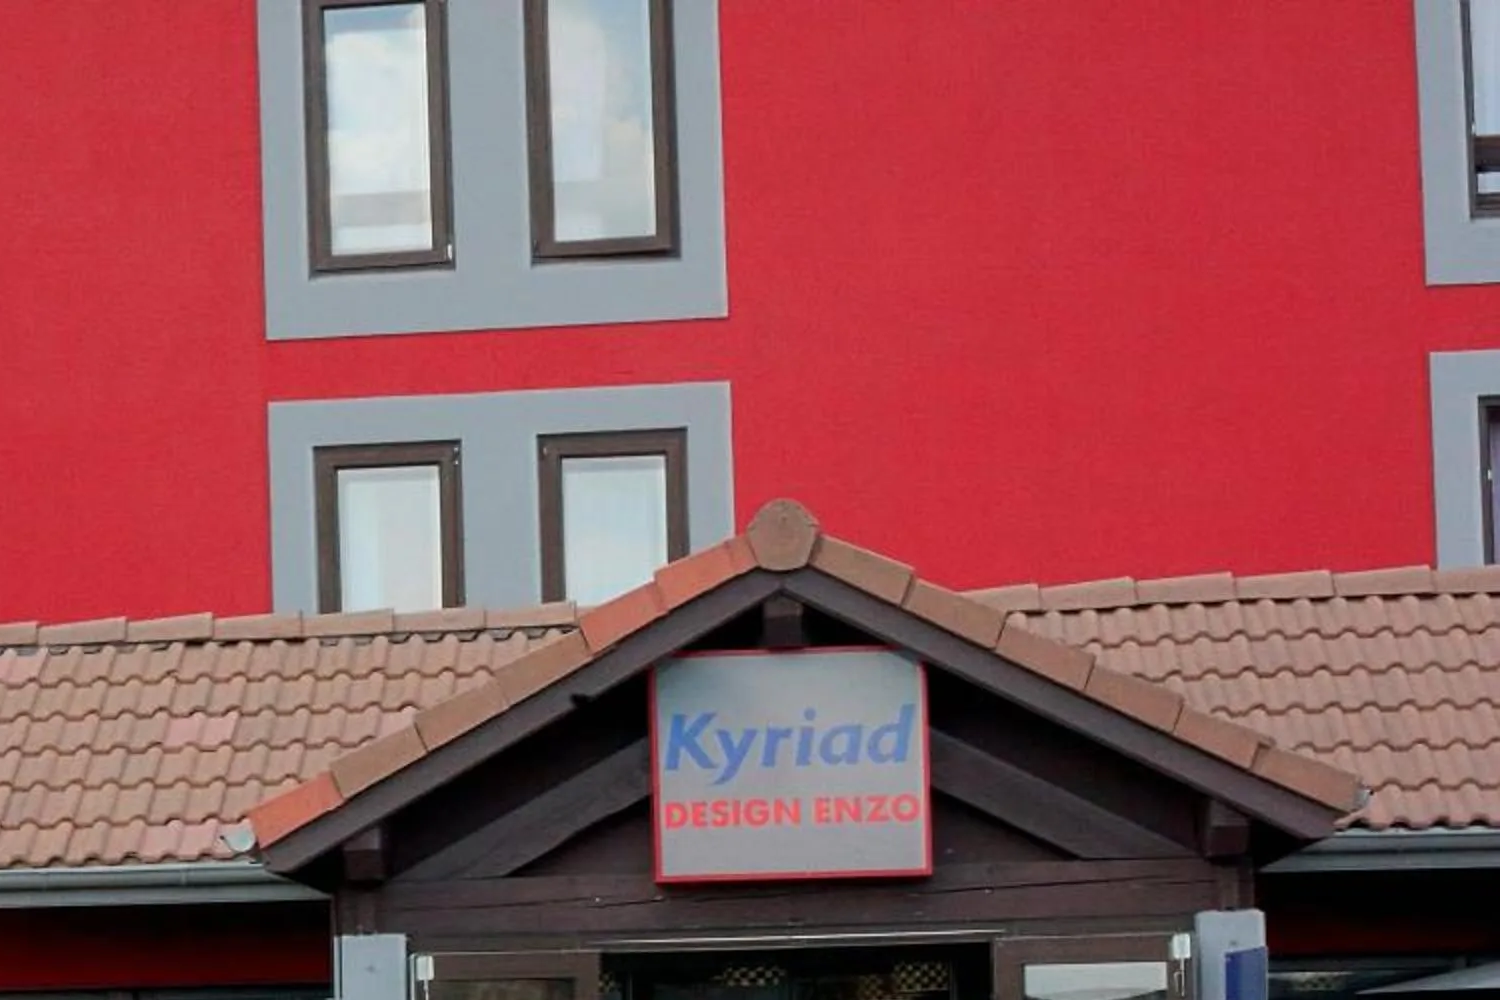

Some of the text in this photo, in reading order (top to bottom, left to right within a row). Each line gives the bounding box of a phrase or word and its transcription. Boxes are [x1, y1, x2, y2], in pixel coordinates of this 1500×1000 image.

[664, 703, 916, 786] Kyriad
[664, 793, 921, 830] DESIGN ENZO
